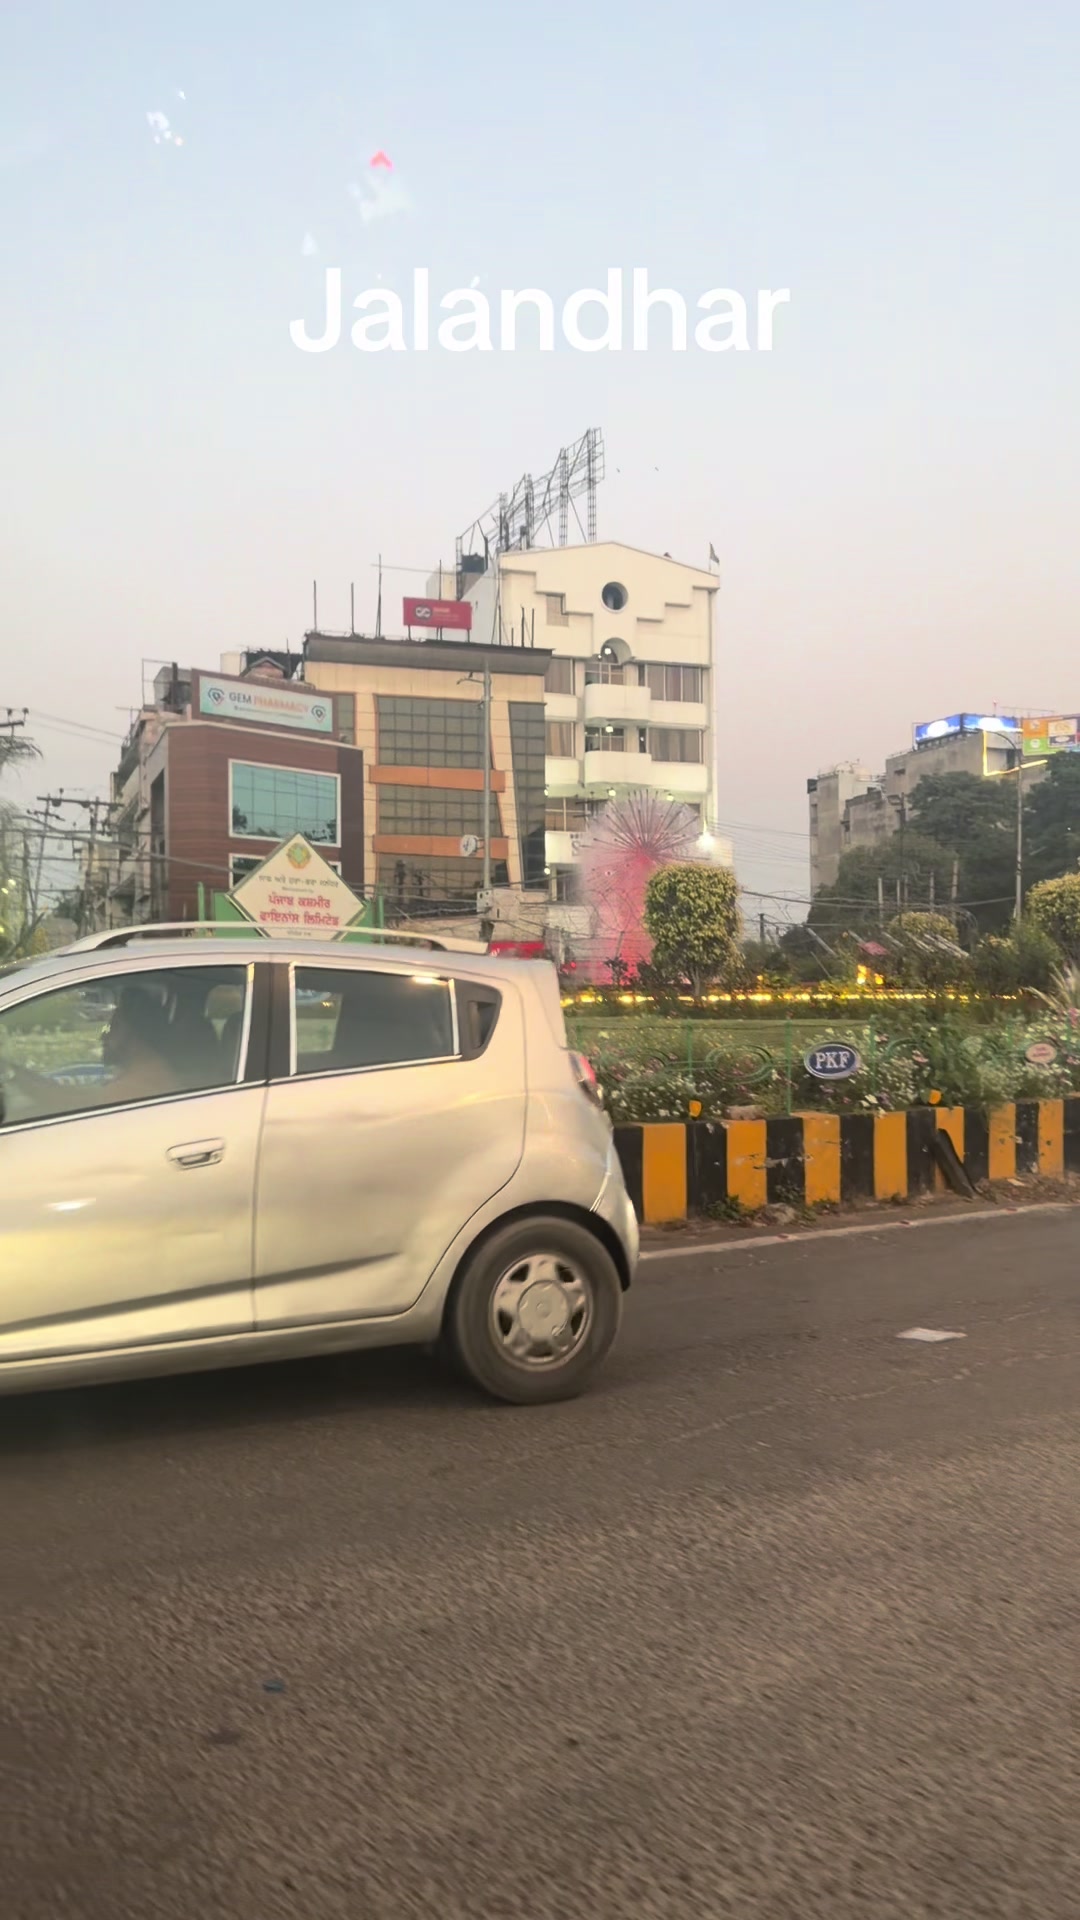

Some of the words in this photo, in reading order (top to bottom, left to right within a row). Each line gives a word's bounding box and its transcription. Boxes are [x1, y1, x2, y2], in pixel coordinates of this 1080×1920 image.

[229, 692, 252, 704] GEM
[253, 695, 309, 713] PHARMACY
[268, 891, 295, 906] ਪੰਜਾਬ
[815, 1051, 850, 1069] PKF
